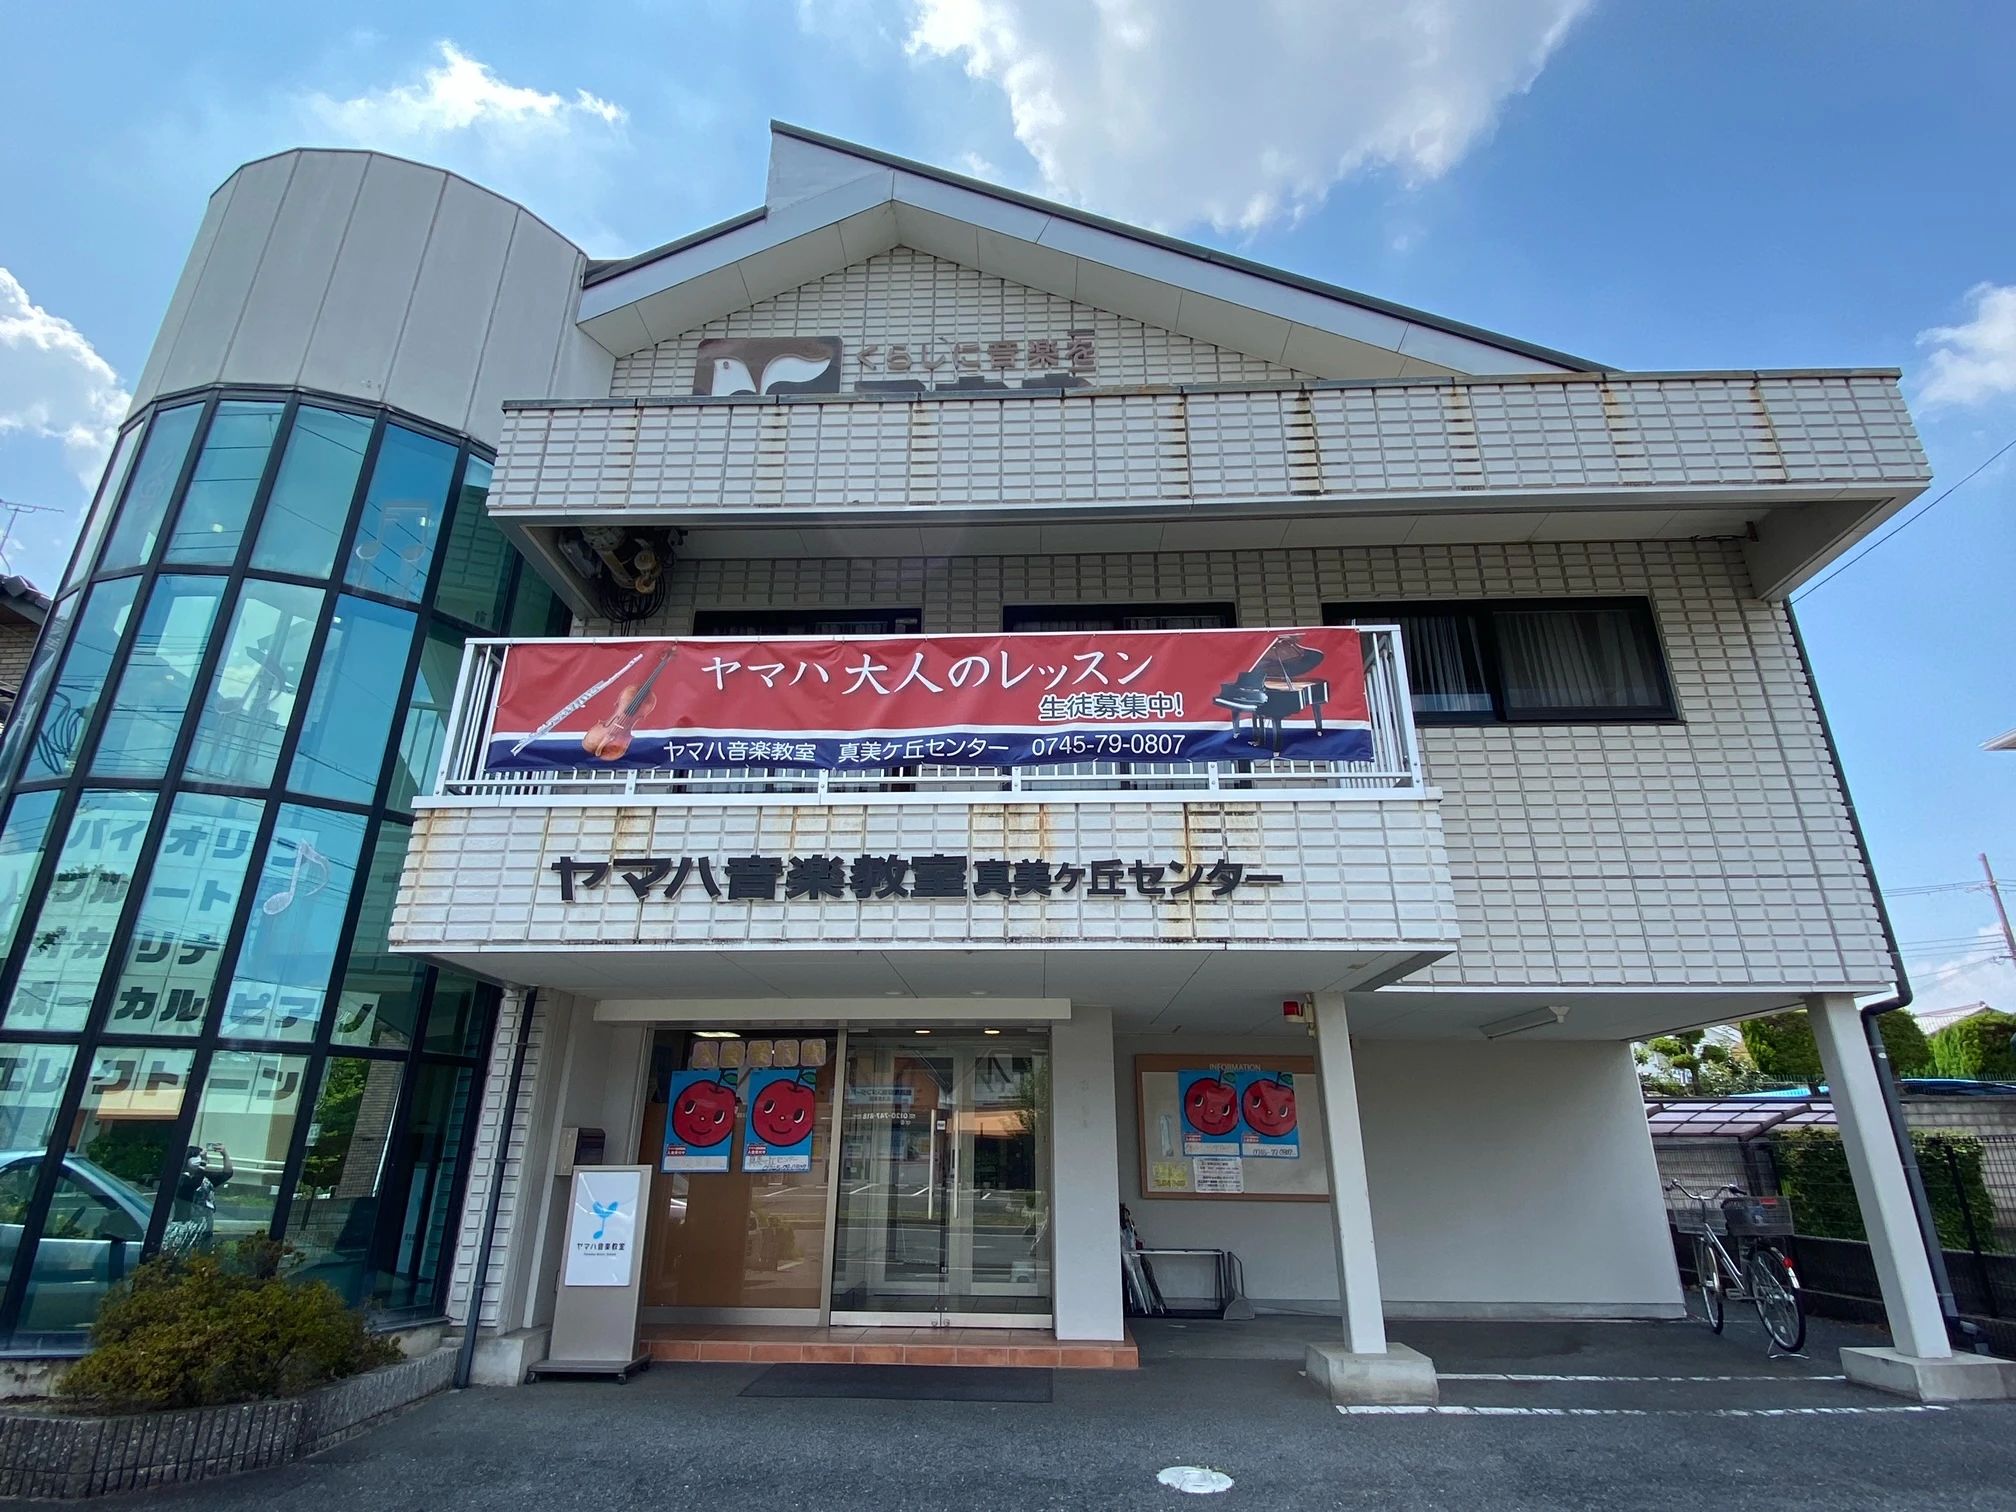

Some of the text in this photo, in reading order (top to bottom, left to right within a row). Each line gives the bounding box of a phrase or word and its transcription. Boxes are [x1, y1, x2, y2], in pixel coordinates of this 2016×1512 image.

[1039, 692, 1183, 721] 生徒募集中!
[664, 741, 816, 762] ヤマハ音楽教室
[1032, 733, 1186, 757] 0745-79-0807
[1209, 1063, 1262, 1072] INFORMATION
[577, 1242, 625, 1251] ヤマハ音楽教室
